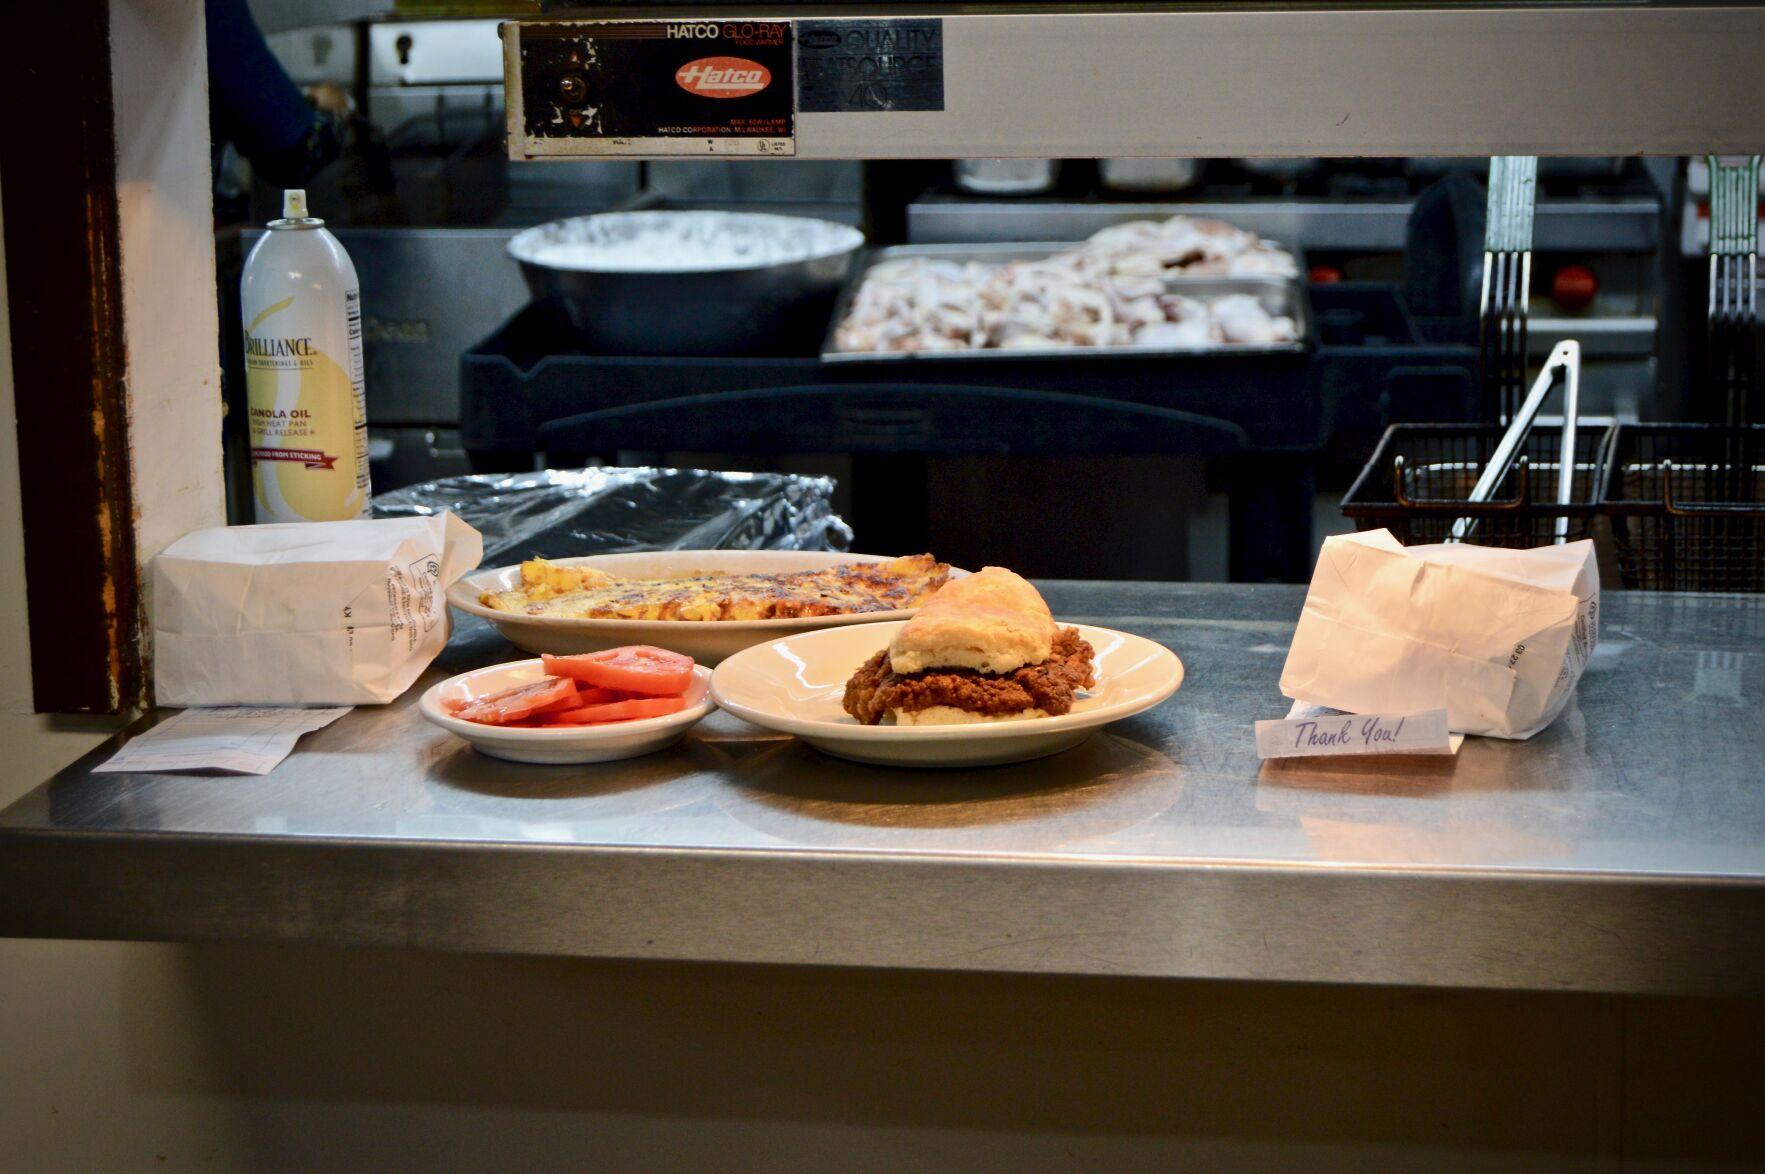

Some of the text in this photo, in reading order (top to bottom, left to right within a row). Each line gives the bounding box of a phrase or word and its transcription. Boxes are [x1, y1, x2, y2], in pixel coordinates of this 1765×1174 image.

[666, 24, 787, 39] HATCO GLO-RAY
[847, 29, 936, 50] QUALITY
[678, 65, 764, 90] Hatco
[244, 330, 313, 356] BRILLIANCE
[250, 408, 311, 418] CANOLA OIL
[266, 420, 286, 428] HEAT
[288, 420, 307, 428] PAN
[275, 429, 308, 437] RELEASE
[290, 452, 322, 460] STICKING
[1295, 717, 1405, 748] Thank You!
